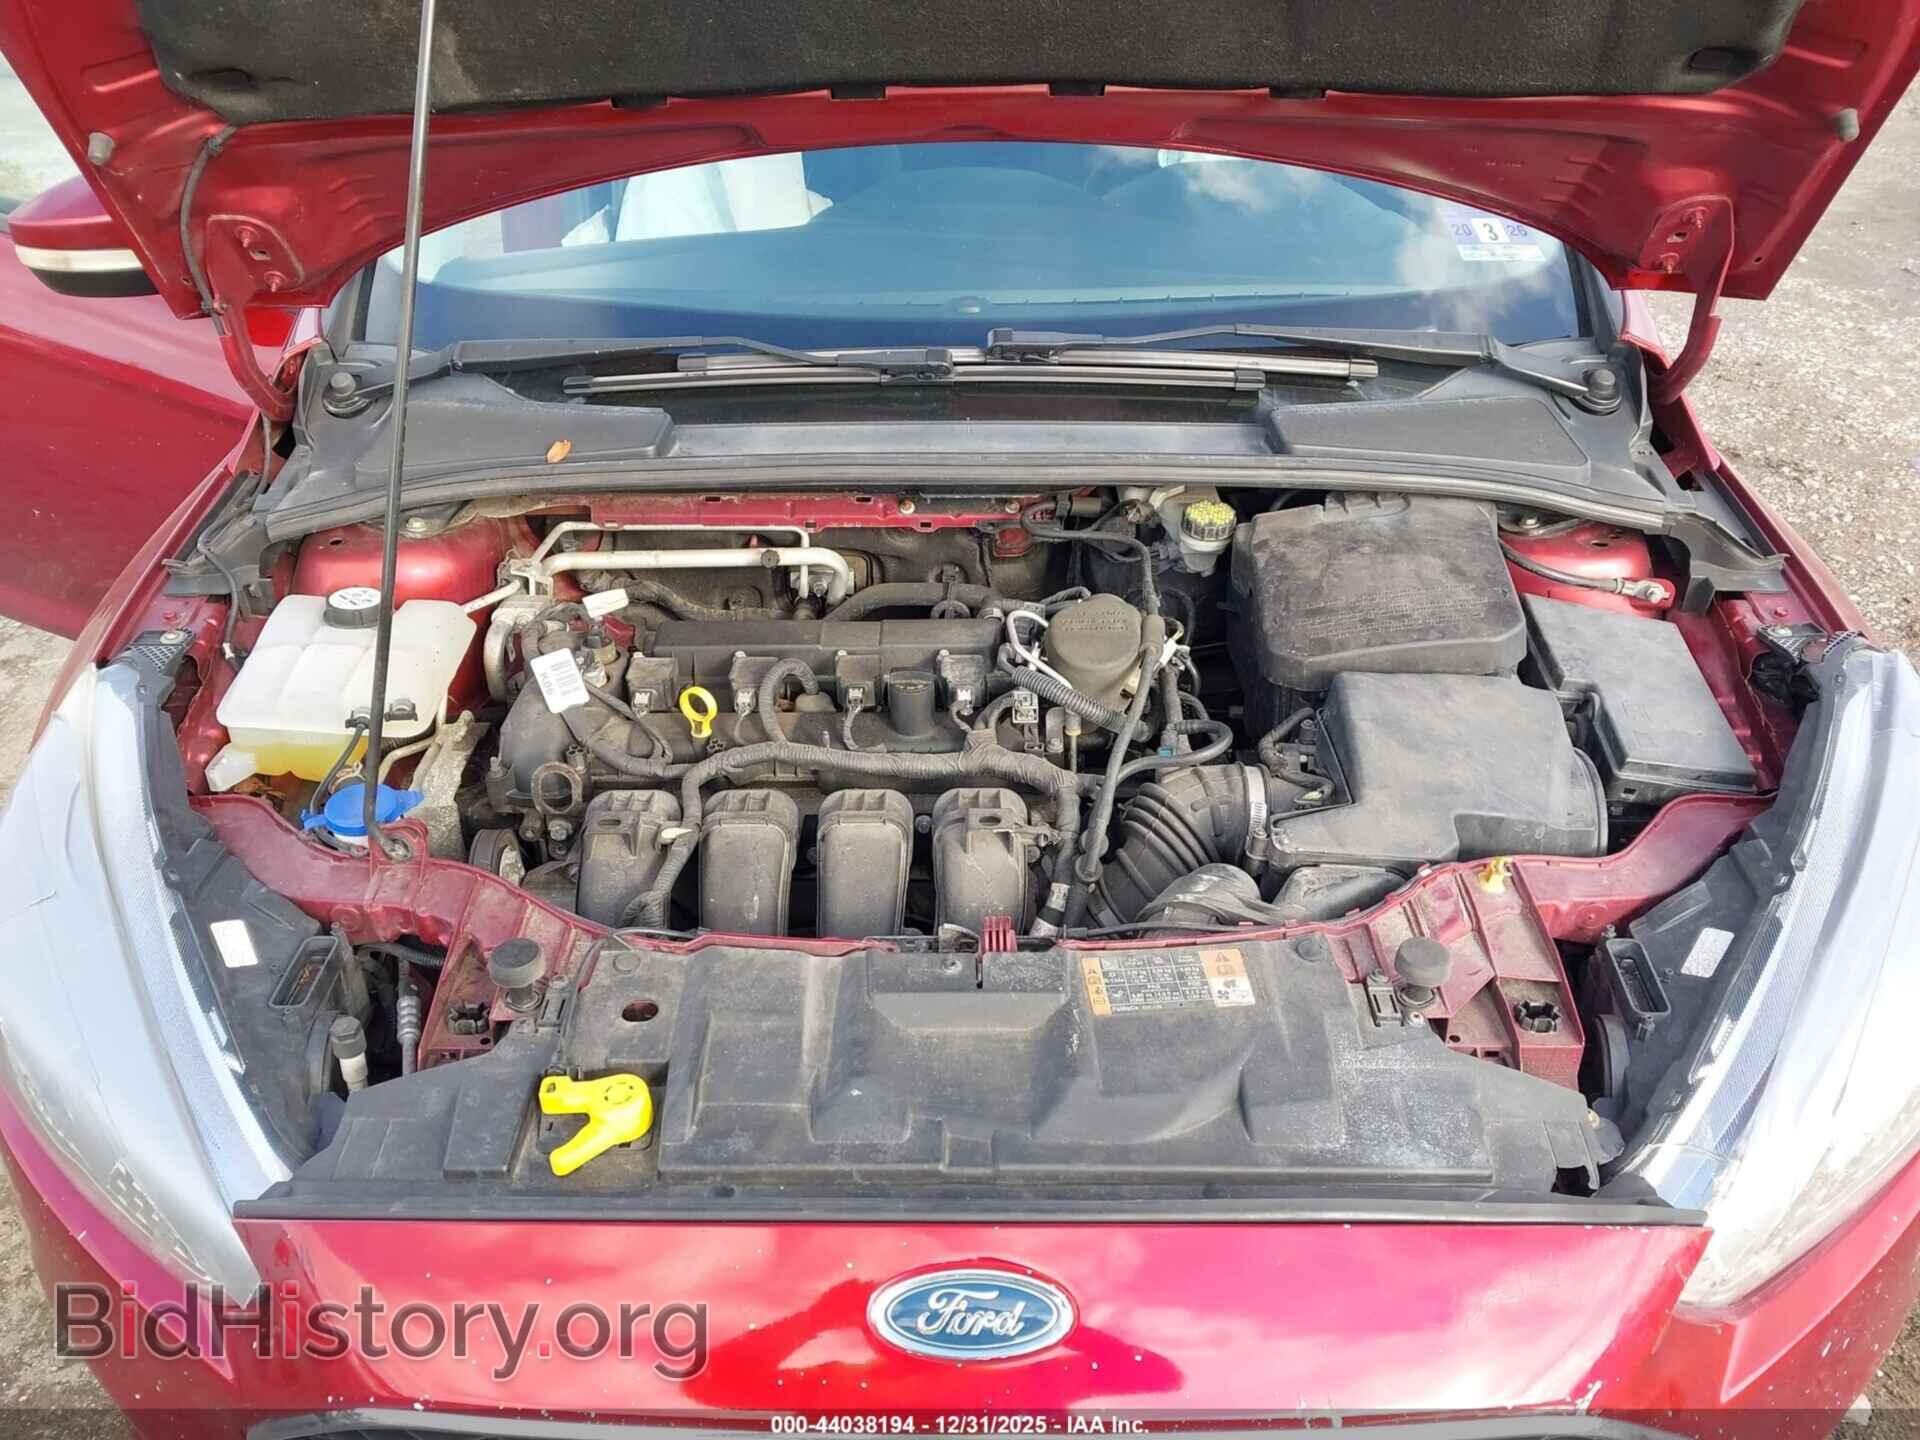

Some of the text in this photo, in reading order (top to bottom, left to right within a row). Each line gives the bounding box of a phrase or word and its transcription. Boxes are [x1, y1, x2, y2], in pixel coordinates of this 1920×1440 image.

[1452, 223, 1472, 236] 20
[1483, 223, 1499, 241] 3
[916, 1287, 1026, 1337] Ford
